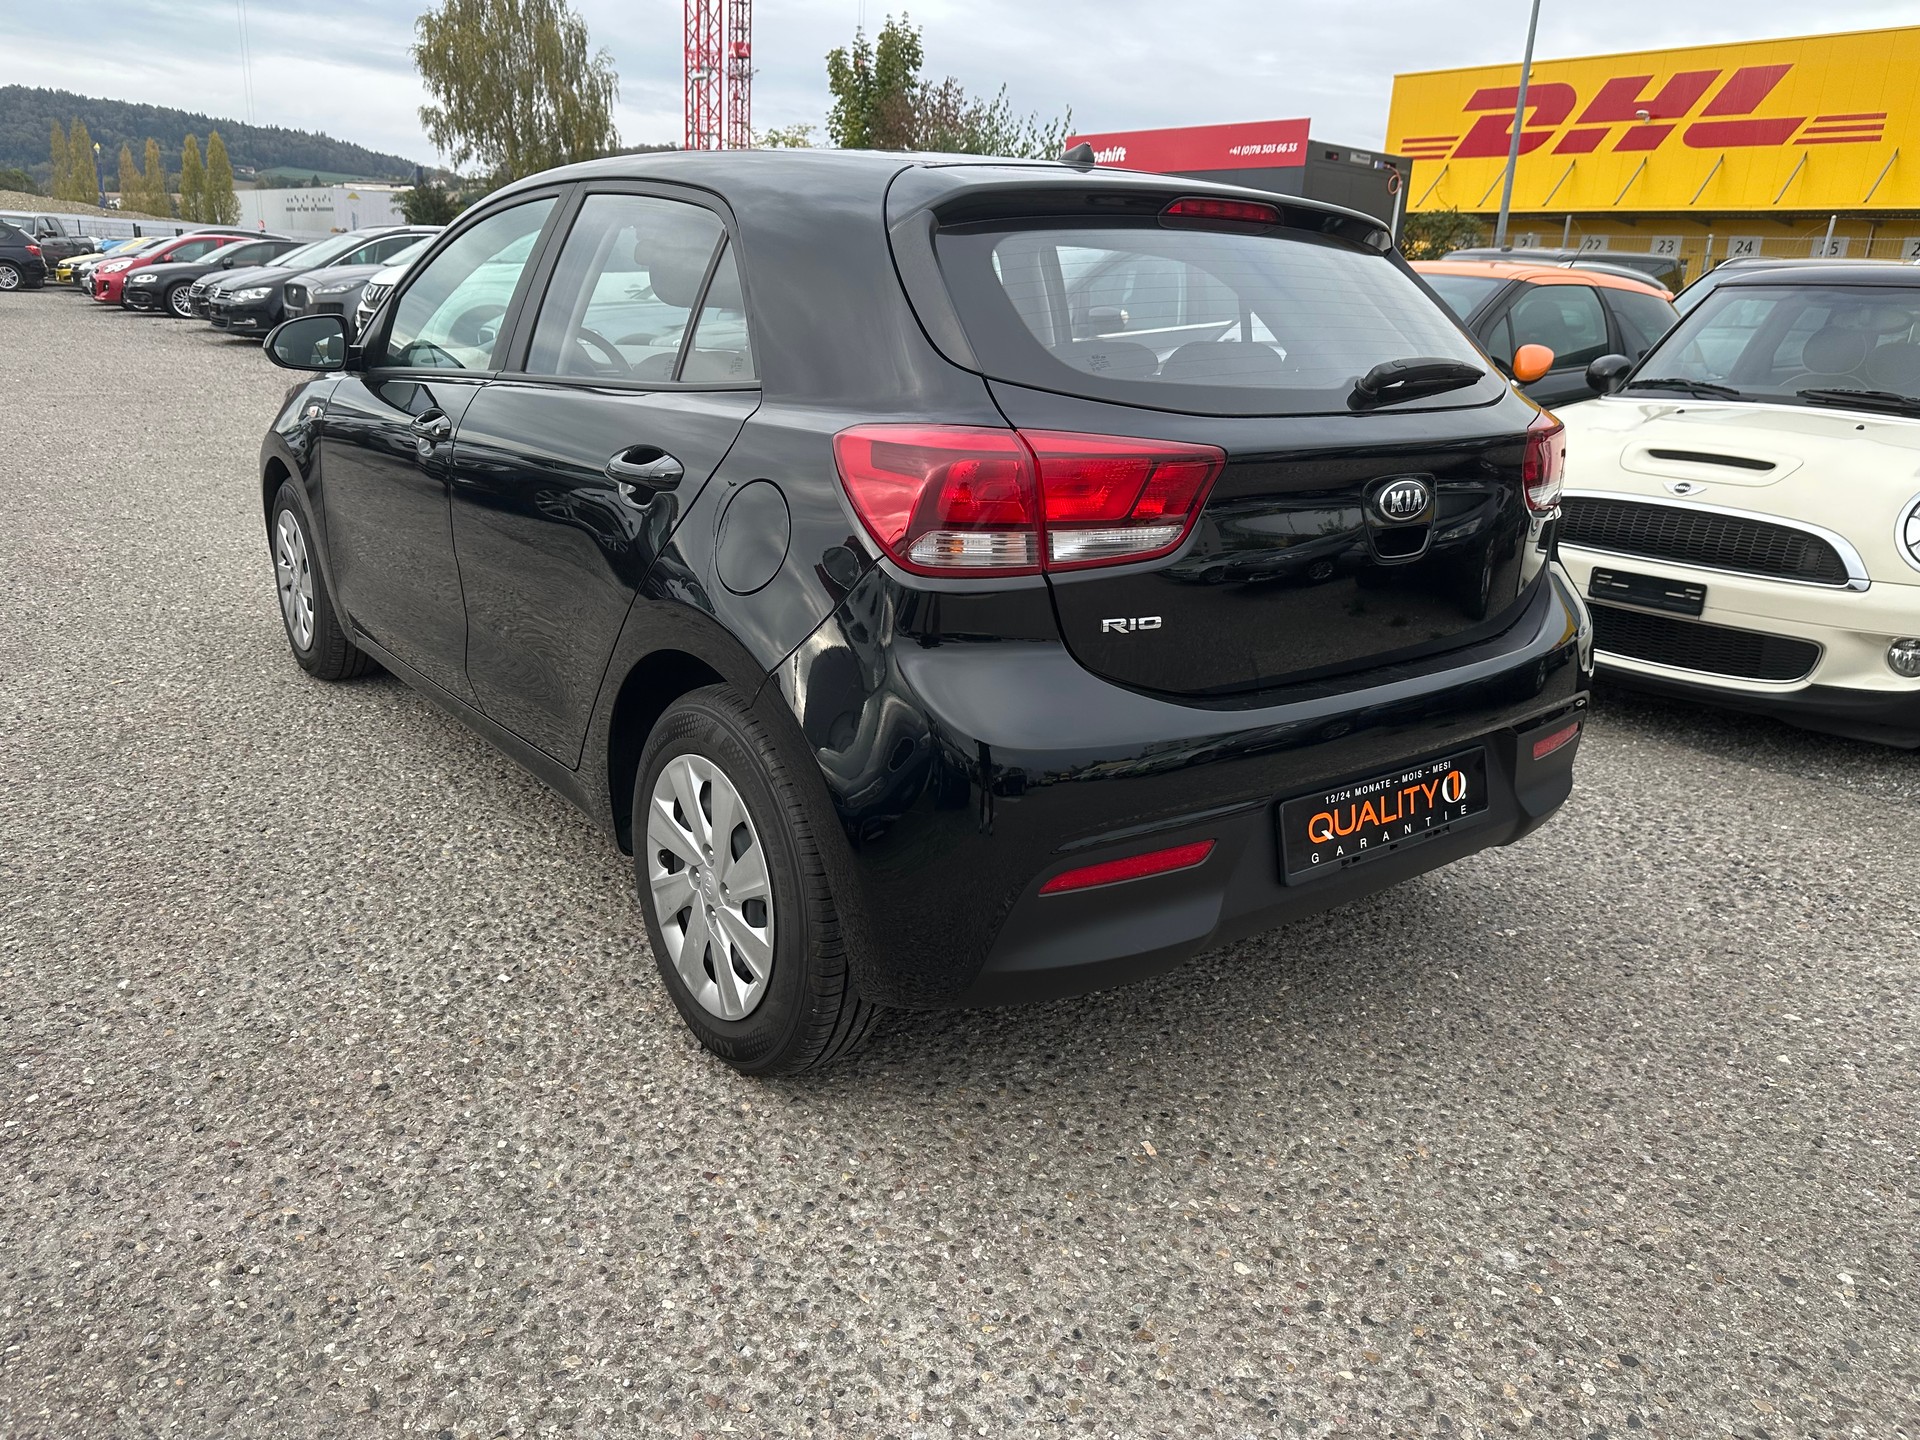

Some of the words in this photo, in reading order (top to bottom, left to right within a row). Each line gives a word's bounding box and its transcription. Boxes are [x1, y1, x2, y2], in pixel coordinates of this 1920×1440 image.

[1450, 63, 1808, 159] DHL
[1229, 145, 1241, 156] +41
[1277, 142, 1287, 153] 66
[1657, 239, 1675, 254] 23
[1735, 240, 1753, 255] 24
[1390, 488, 1423, 513] KIA
[1101, 616, 1162, 634] RIO
[1324, 791, 1351, 805] 12/24
[1354, 778, 1391, 797] MONATE
[1401, 769, 1423, 783] MOIS
[1432, 760, 1451, 774] MESI
[1308, 778, 1440, 844] QUALITY
[1311, 804, 1467, 864] GARANTIE
